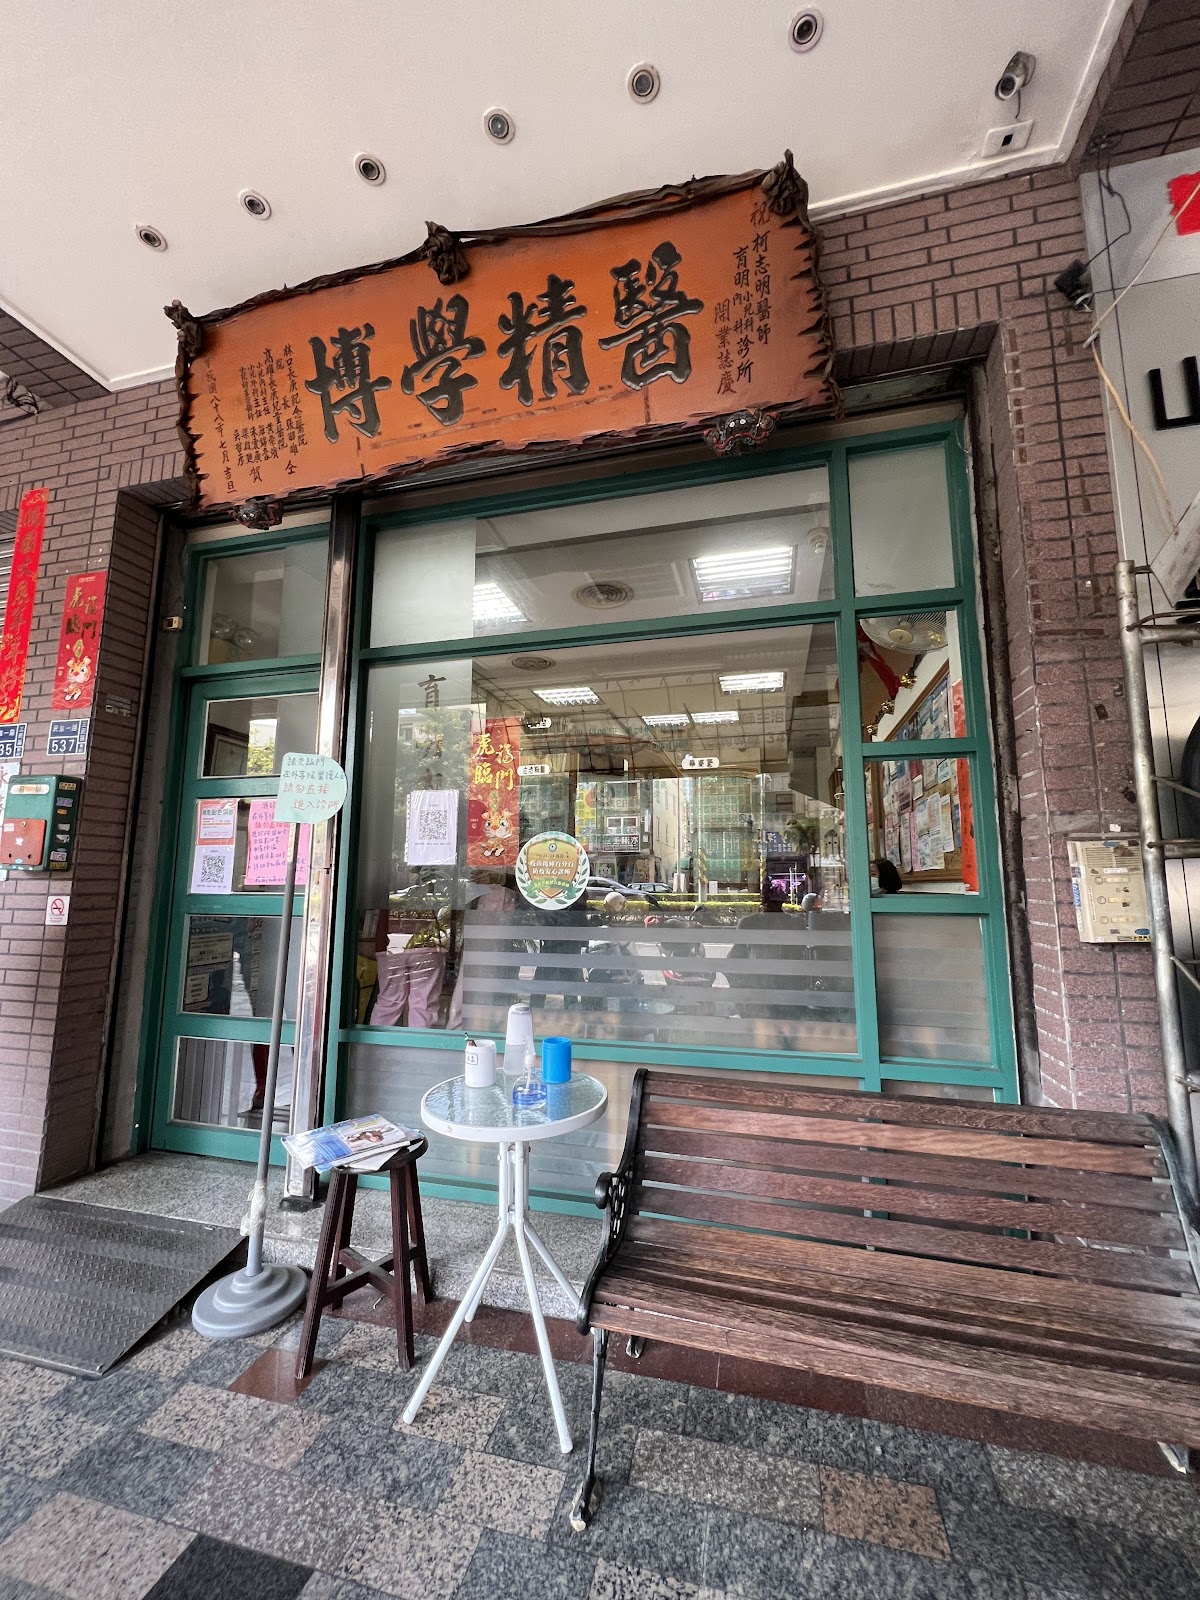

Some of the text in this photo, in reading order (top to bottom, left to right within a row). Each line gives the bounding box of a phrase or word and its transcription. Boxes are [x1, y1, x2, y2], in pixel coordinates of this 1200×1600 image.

[51, 739, 75, 752] 537
[283, 783, 330, 795] 請勿直接
[293, 800, 341, 811] 進入診所
